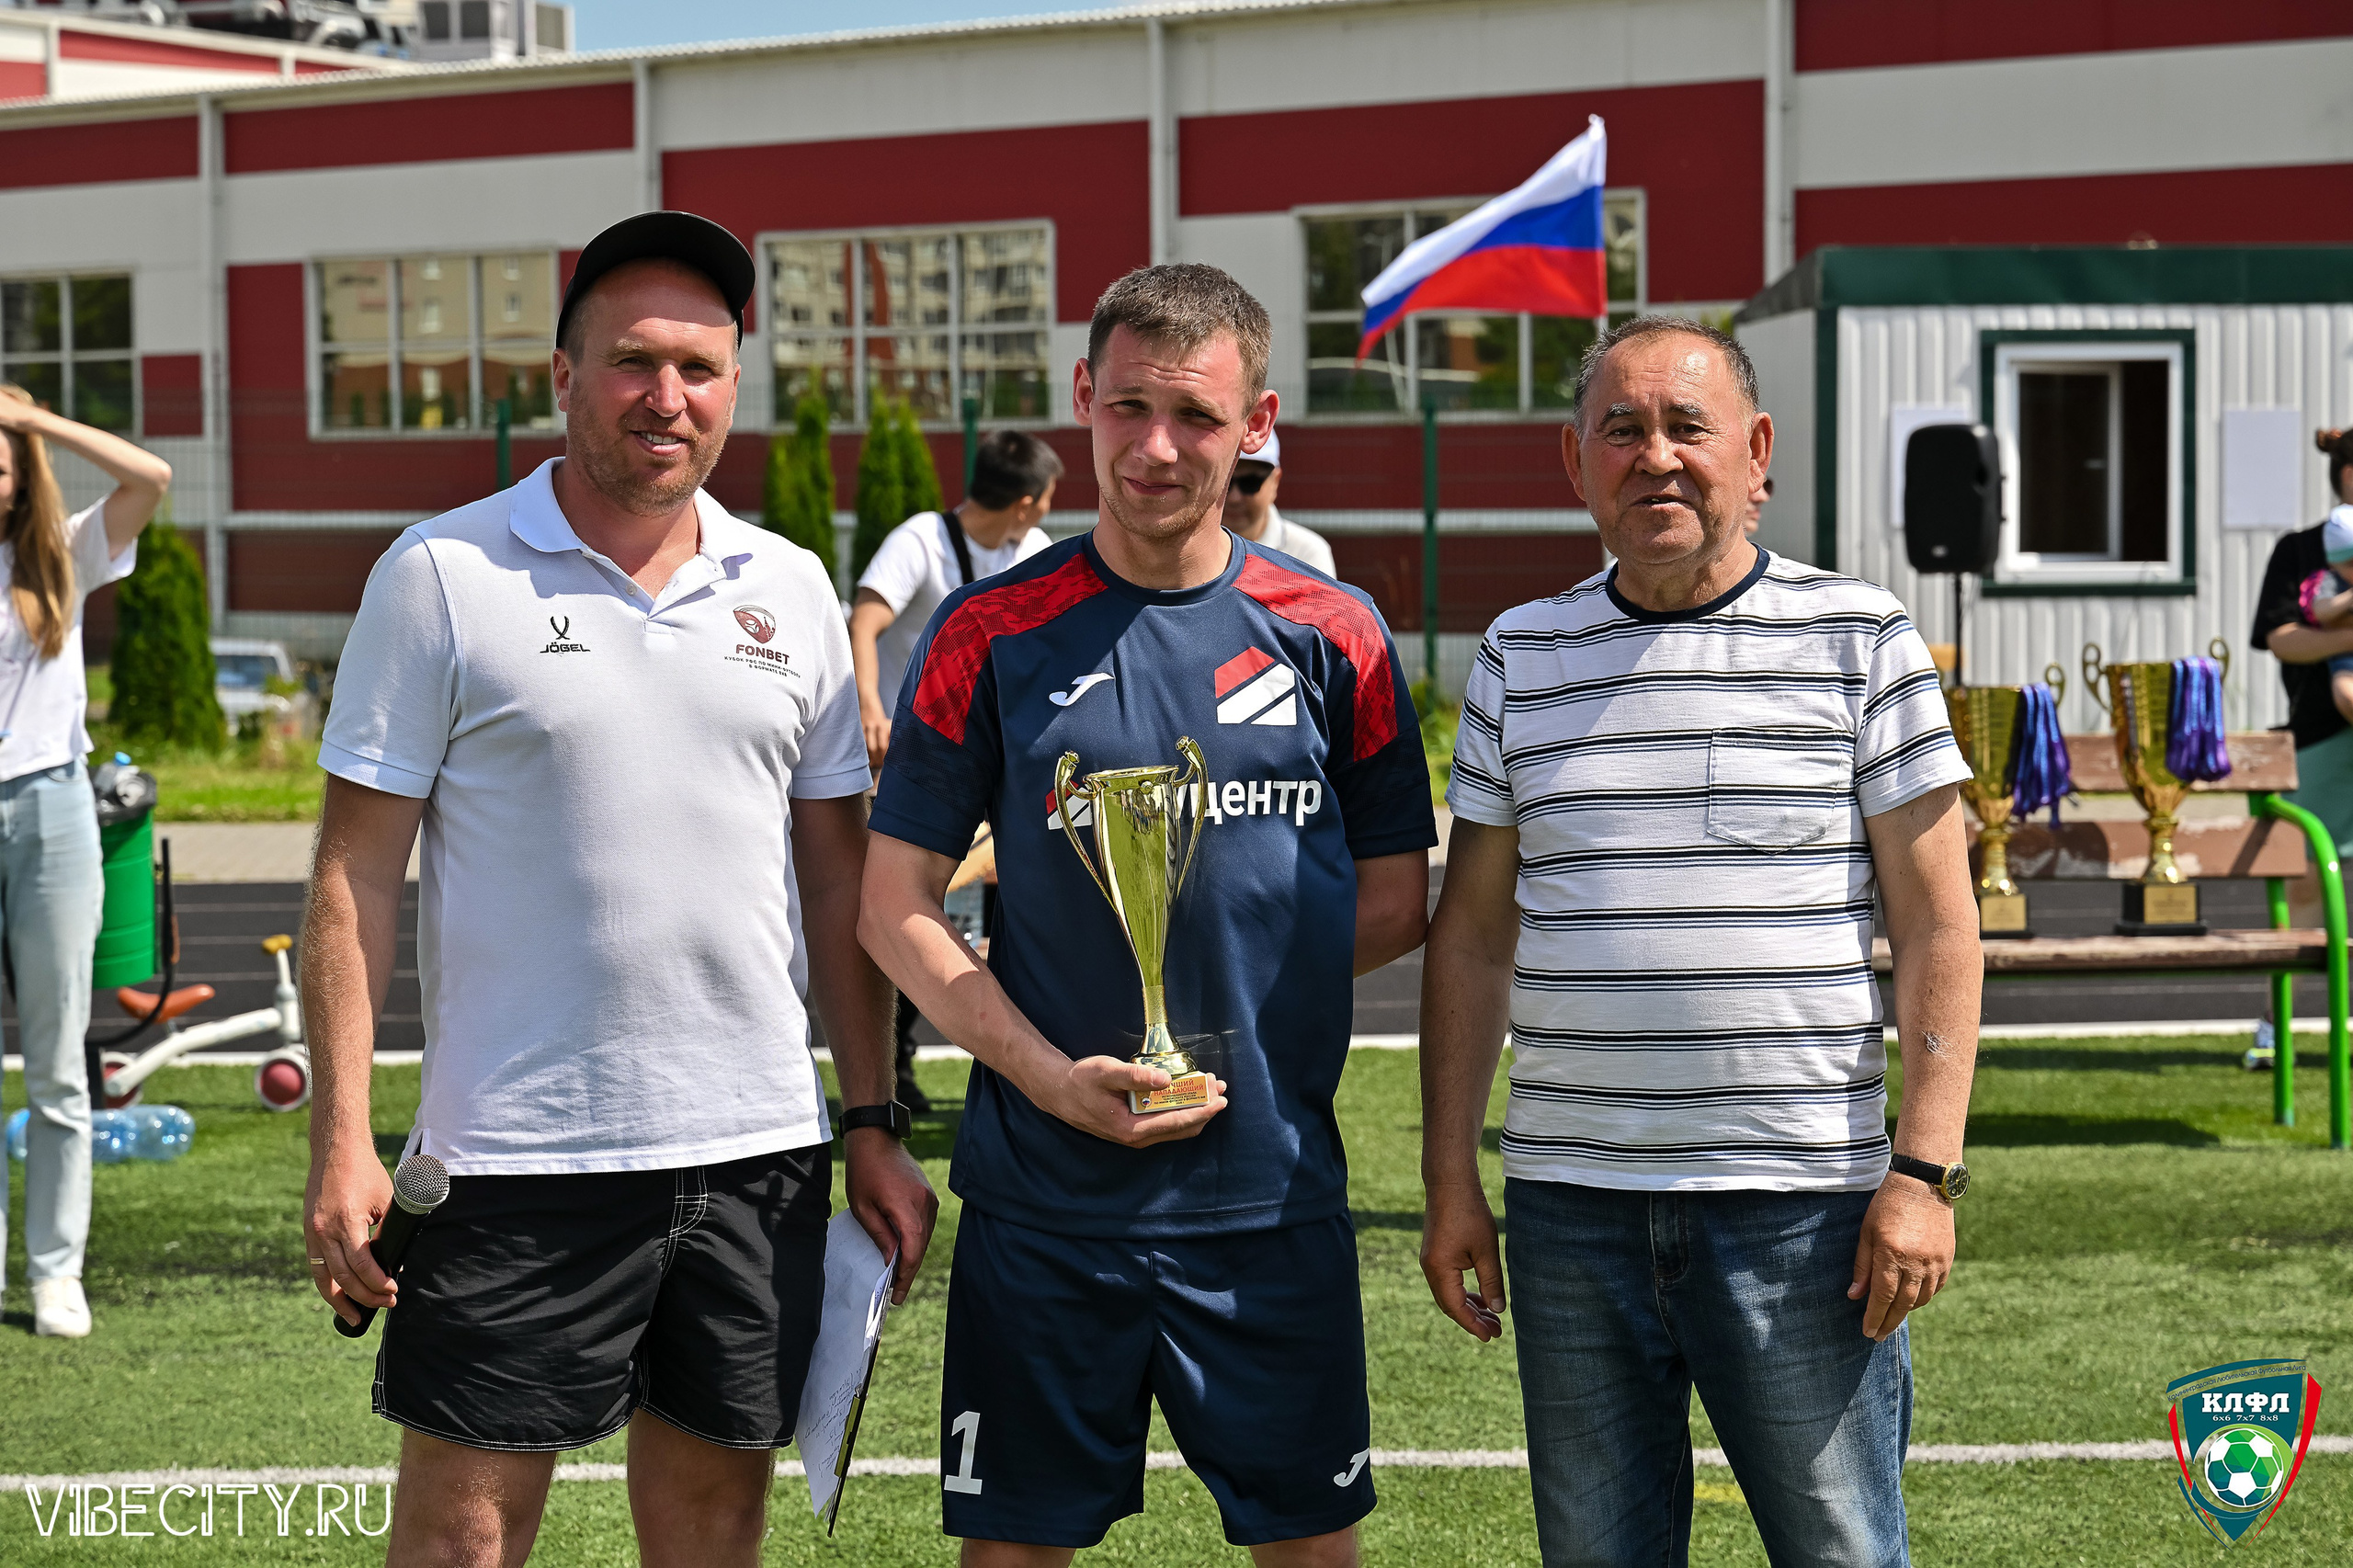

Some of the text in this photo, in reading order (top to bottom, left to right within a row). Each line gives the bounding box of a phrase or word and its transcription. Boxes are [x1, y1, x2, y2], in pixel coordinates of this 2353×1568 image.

[540, 642, 591, 653] JÖGEL
[735, 643, 790, 665] FONBET
[944, 1411, 983, 1495] 1
